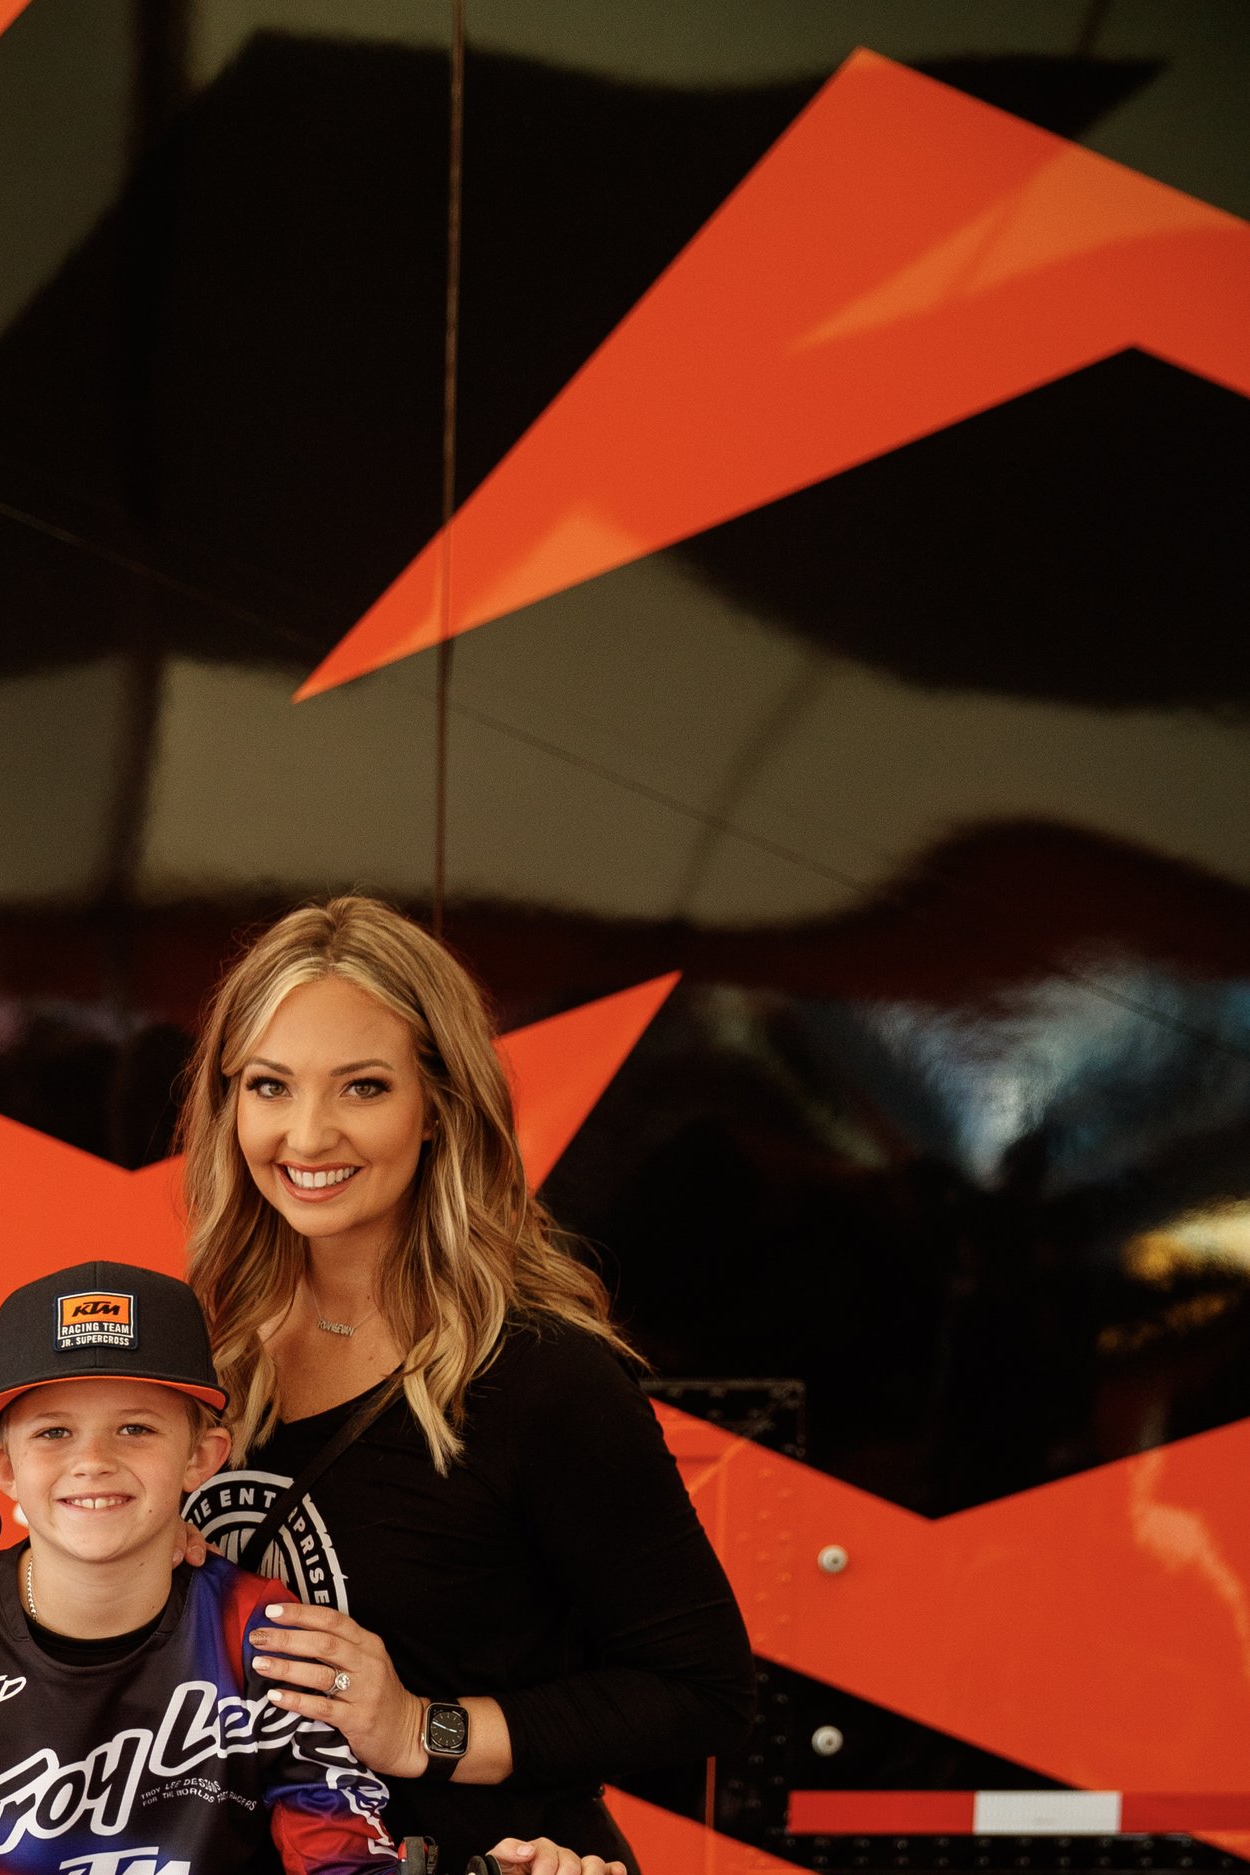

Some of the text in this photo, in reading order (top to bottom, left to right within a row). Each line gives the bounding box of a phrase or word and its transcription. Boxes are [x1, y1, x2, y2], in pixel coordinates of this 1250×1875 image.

[71, 1300, 121, 1318] KTM
[61, 1322, 129, 1336] RACING TEAM
[61, 1334, 130, 1348] JR. SUPERCROSS
